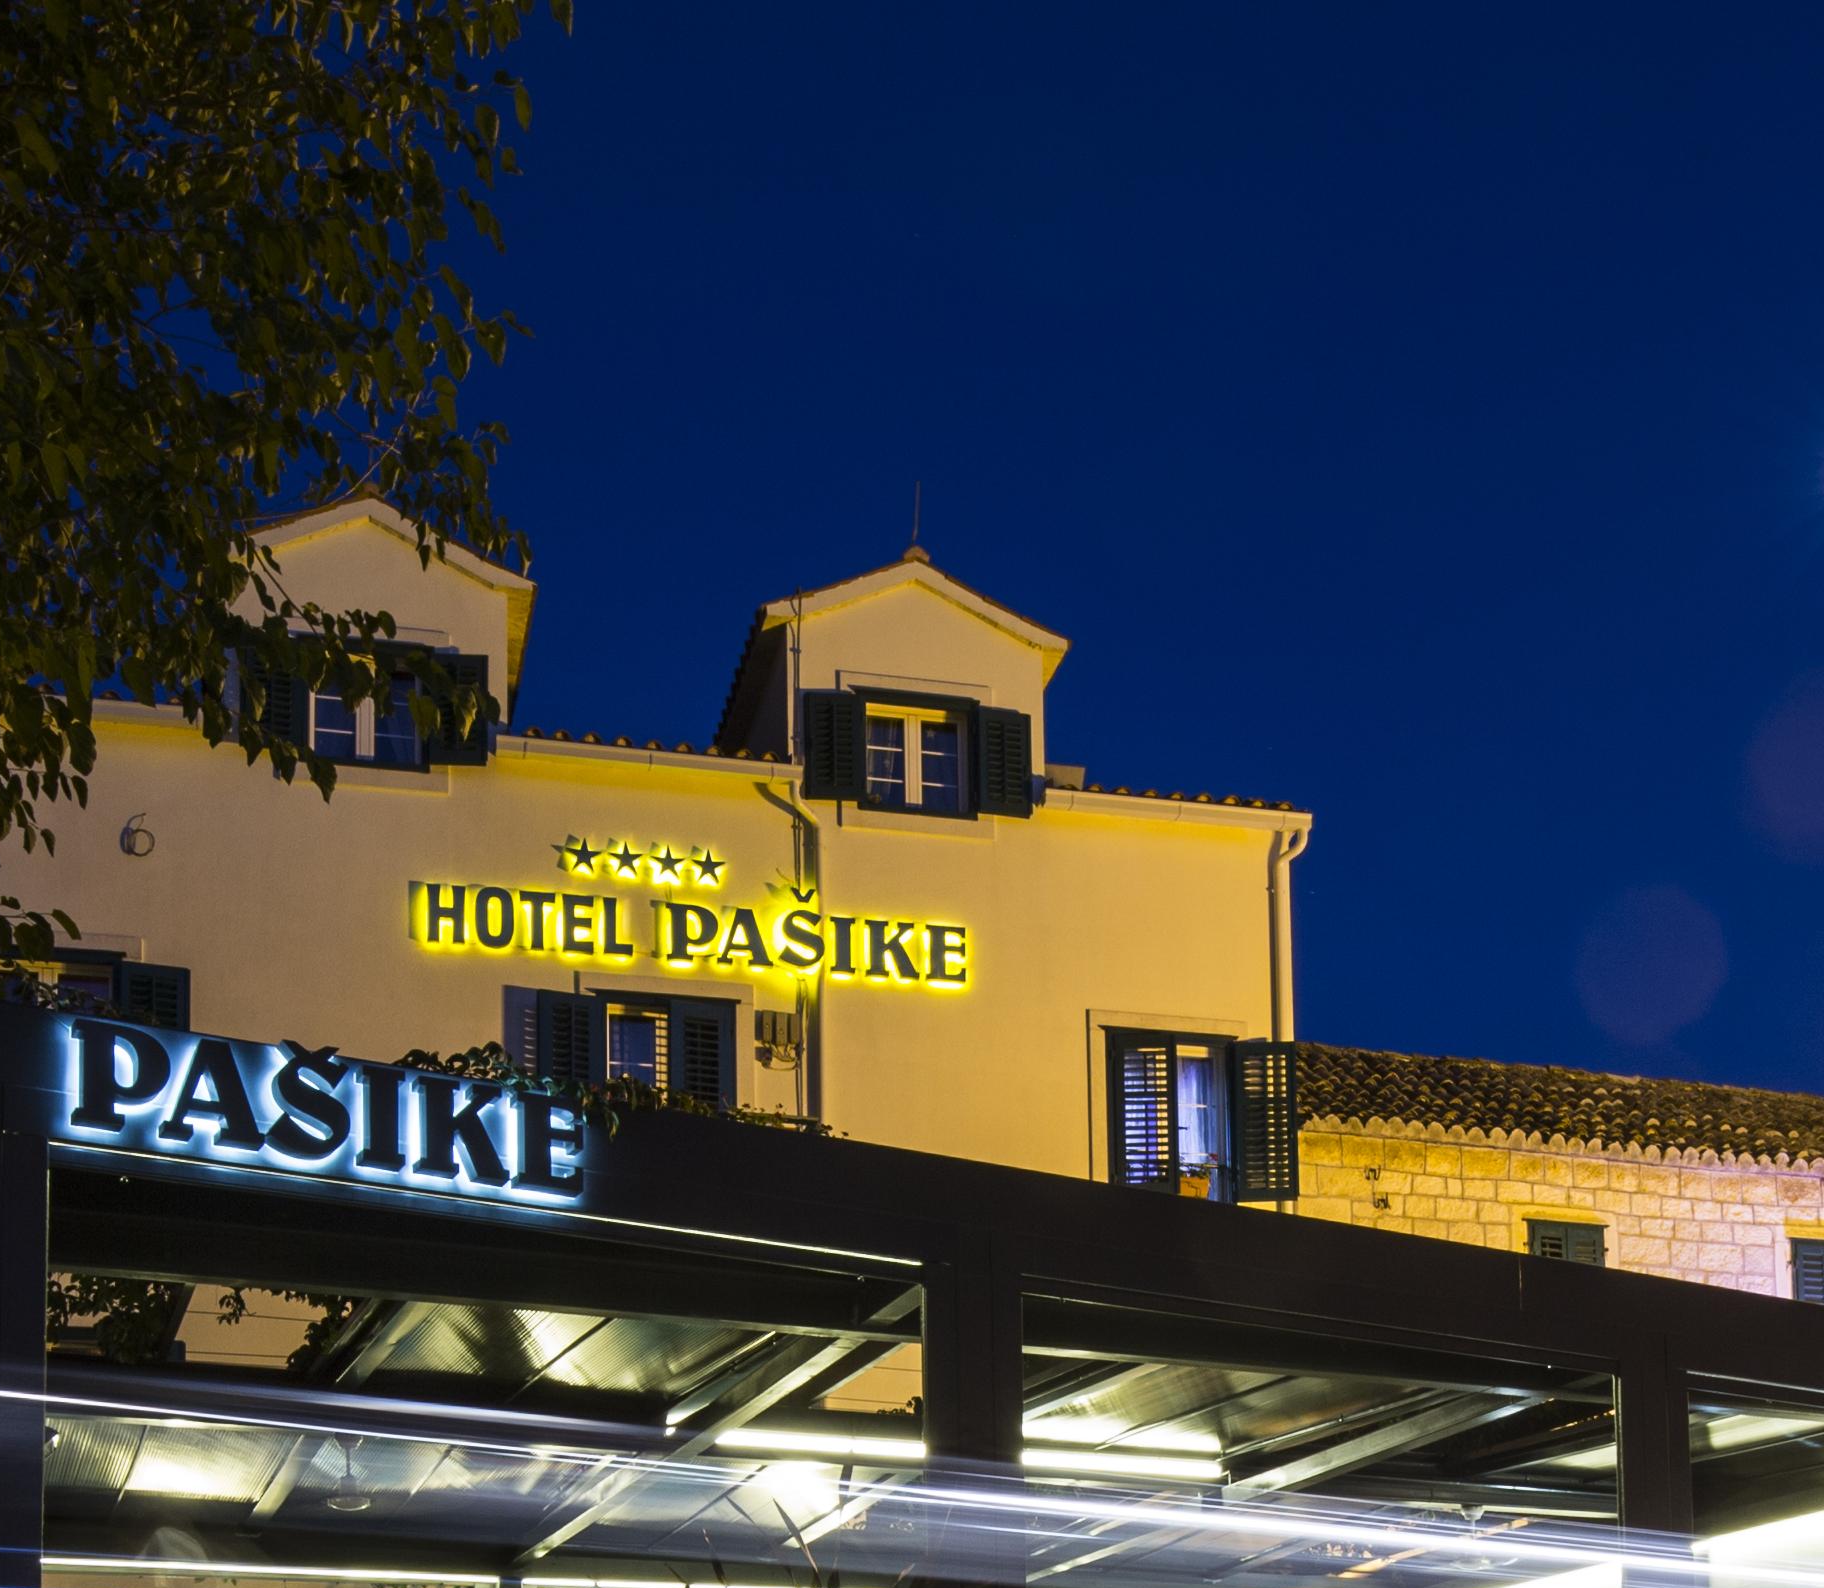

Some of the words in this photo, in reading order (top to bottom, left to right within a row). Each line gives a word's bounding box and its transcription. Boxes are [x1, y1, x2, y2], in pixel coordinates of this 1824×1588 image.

[425, 882, 634, 957] HOTEL
[664, 887, 967, 983] PAŠIKE
[70, 1017, 585, 1198] PAŠIKE
